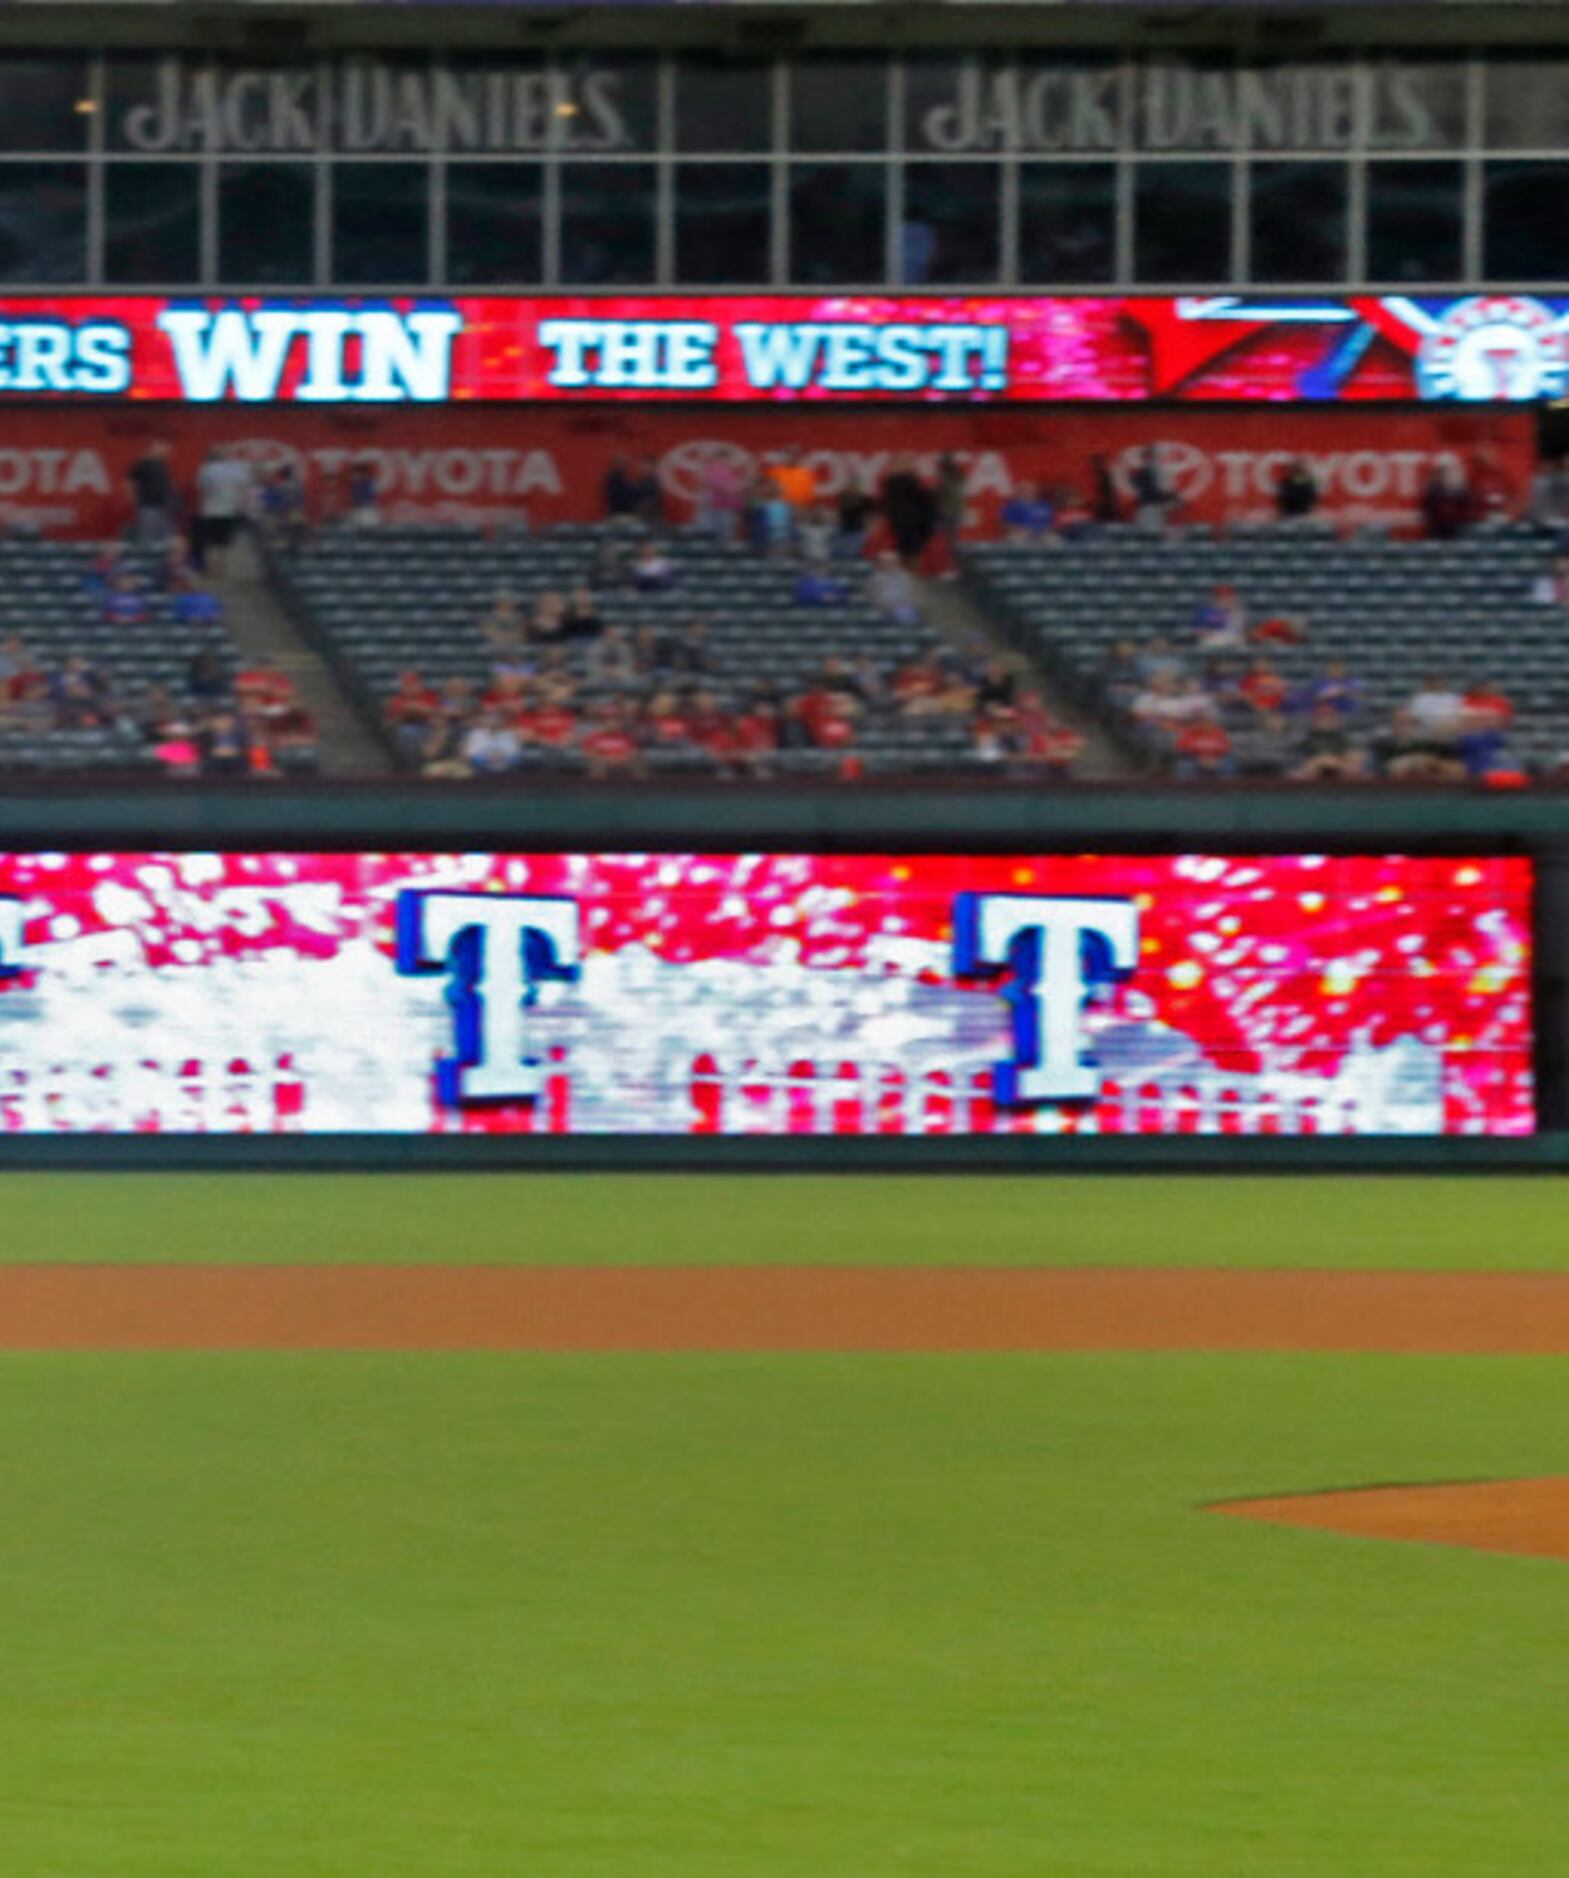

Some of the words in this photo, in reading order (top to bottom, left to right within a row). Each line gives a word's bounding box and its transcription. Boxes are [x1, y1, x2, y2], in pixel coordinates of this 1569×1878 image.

[124, 56, 316, 149] JACK
[924, 60, 1115, 149] JACK
[157, 308, 464, 401] WIN
[538, 318, 719, 388] THE
[732, 321, 1011, 391] WEST!
[396, 889, 579, 1106] T
[953, 890, 1140, 1108] T
